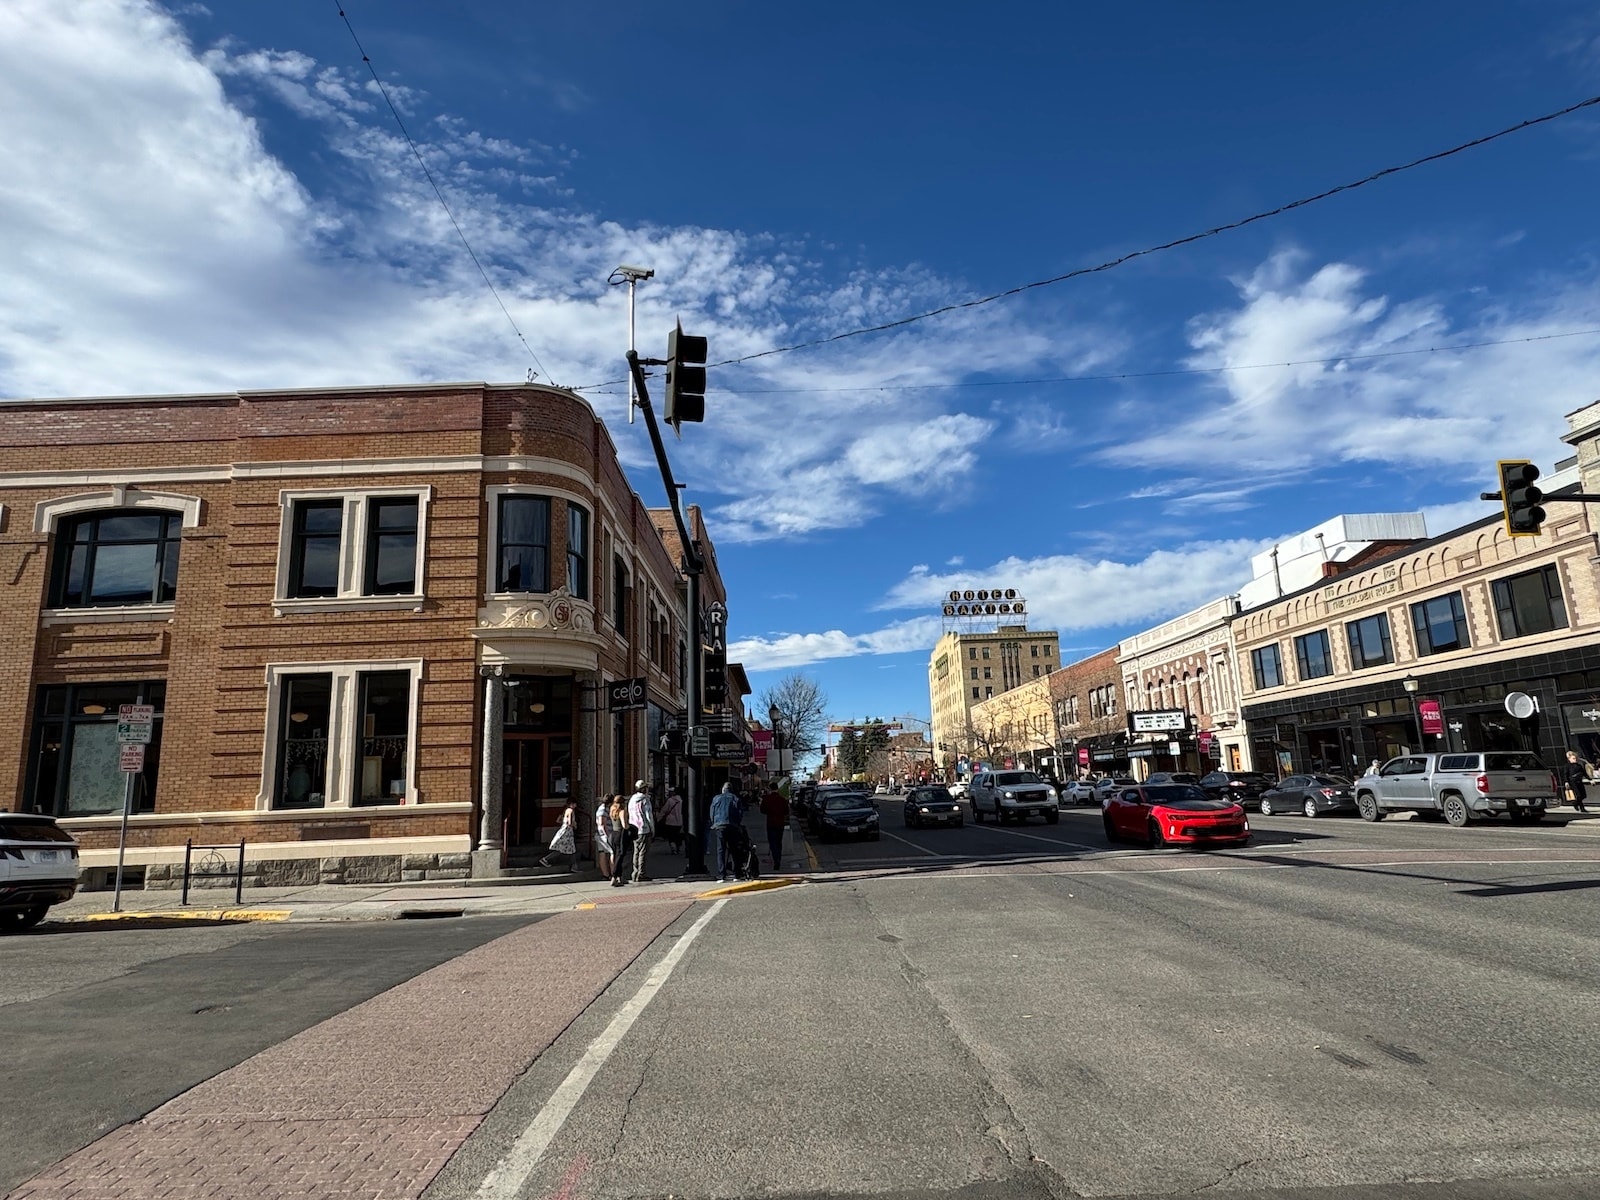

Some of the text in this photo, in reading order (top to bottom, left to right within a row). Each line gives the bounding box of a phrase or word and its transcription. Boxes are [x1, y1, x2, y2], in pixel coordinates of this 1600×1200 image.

[951, 589, 1015, 601] HOTEL
[1376, 583, 1396, 597] RULE
[945, 603, 1023, 615] BAXTER
[613, 679, 642, 704] cello
